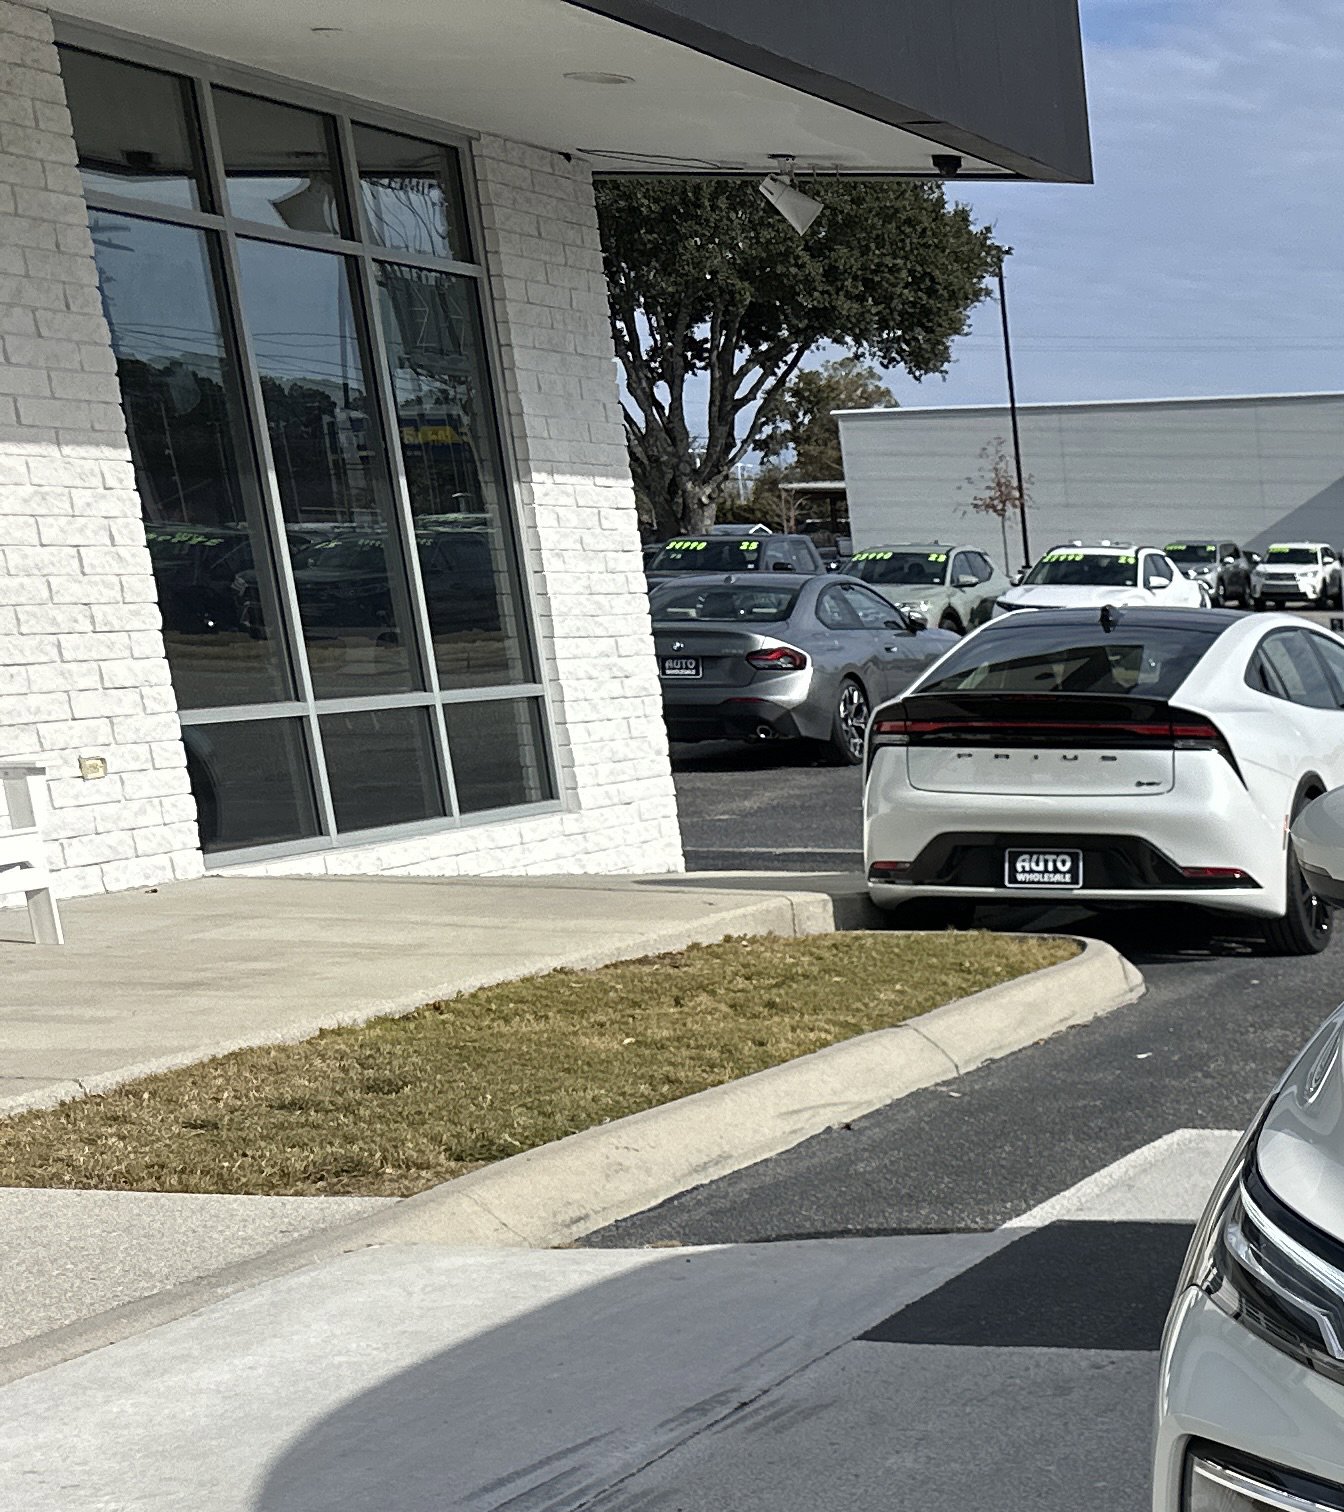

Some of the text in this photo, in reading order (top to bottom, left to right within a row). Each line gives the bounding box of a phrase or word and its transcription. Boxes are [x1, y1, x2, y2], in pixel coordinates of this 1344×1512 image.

[665, 659, 696, 669] AUTO
[1015, 854, 1072, 872] AUTO
[1015, 873, 1072, 883] WHOLESALE
